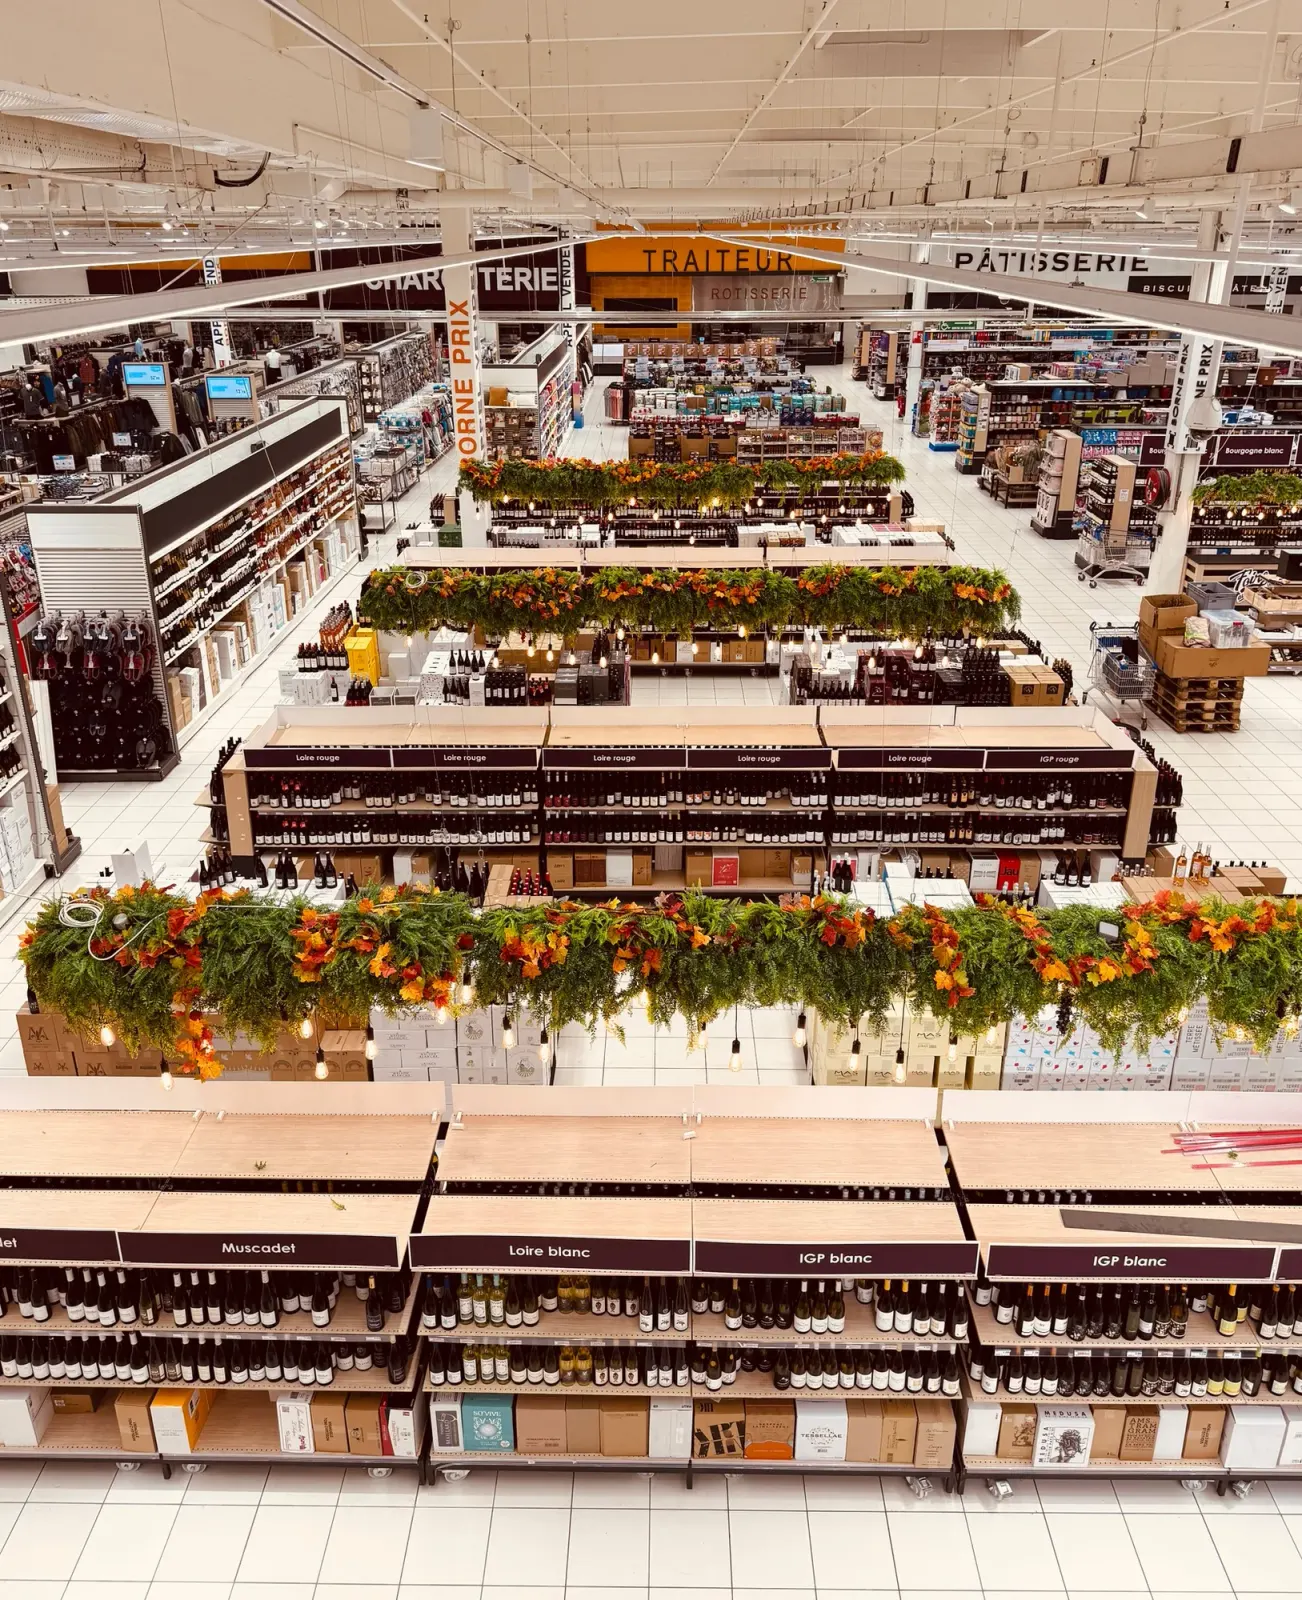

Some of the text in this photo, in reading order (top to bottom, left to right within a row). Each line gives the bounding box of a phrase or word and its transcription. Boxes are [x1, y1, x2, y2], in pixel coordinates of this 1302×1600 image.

[561, 229, 572, 297] VENDER
[643, 249, 794, 272] TRAITEUR
[955, 248, 1149, 272] PÂTISSERIE
[365, 267, 559, 291] CHARTERIE
[711, 287, 808, 300] ROTISSERIE
[449, 299, 472, 364] PRIX
[1198, 344, 1214, 376] PRIX
[1171, 344, 1190, 427] BORNE PRIX
[454, 378, 478, 456] ORNE
[1225, 447, 1263, 456] Bourgogne
[296, 754, 340, 763] Loire rouge
[444, 754, 487, 763] Loire rouge
[593, 754, 636, 764] Loire rouge
[737, 754, 781, 764] Loire rouge
[909, 756, 932, 764] rouge
[1040, 755, 1079, 764] IGP rouge
[222, 1242, 296, 1254] Muscadet
[509, 1245, 590, 1258] Loire blanc
[799, 1252, 872, 1264] IGP blanc
[1093, 1256, 1167, 1267] IGP blanc
[1038, 1426, 1049, 1463] MEDUSA
